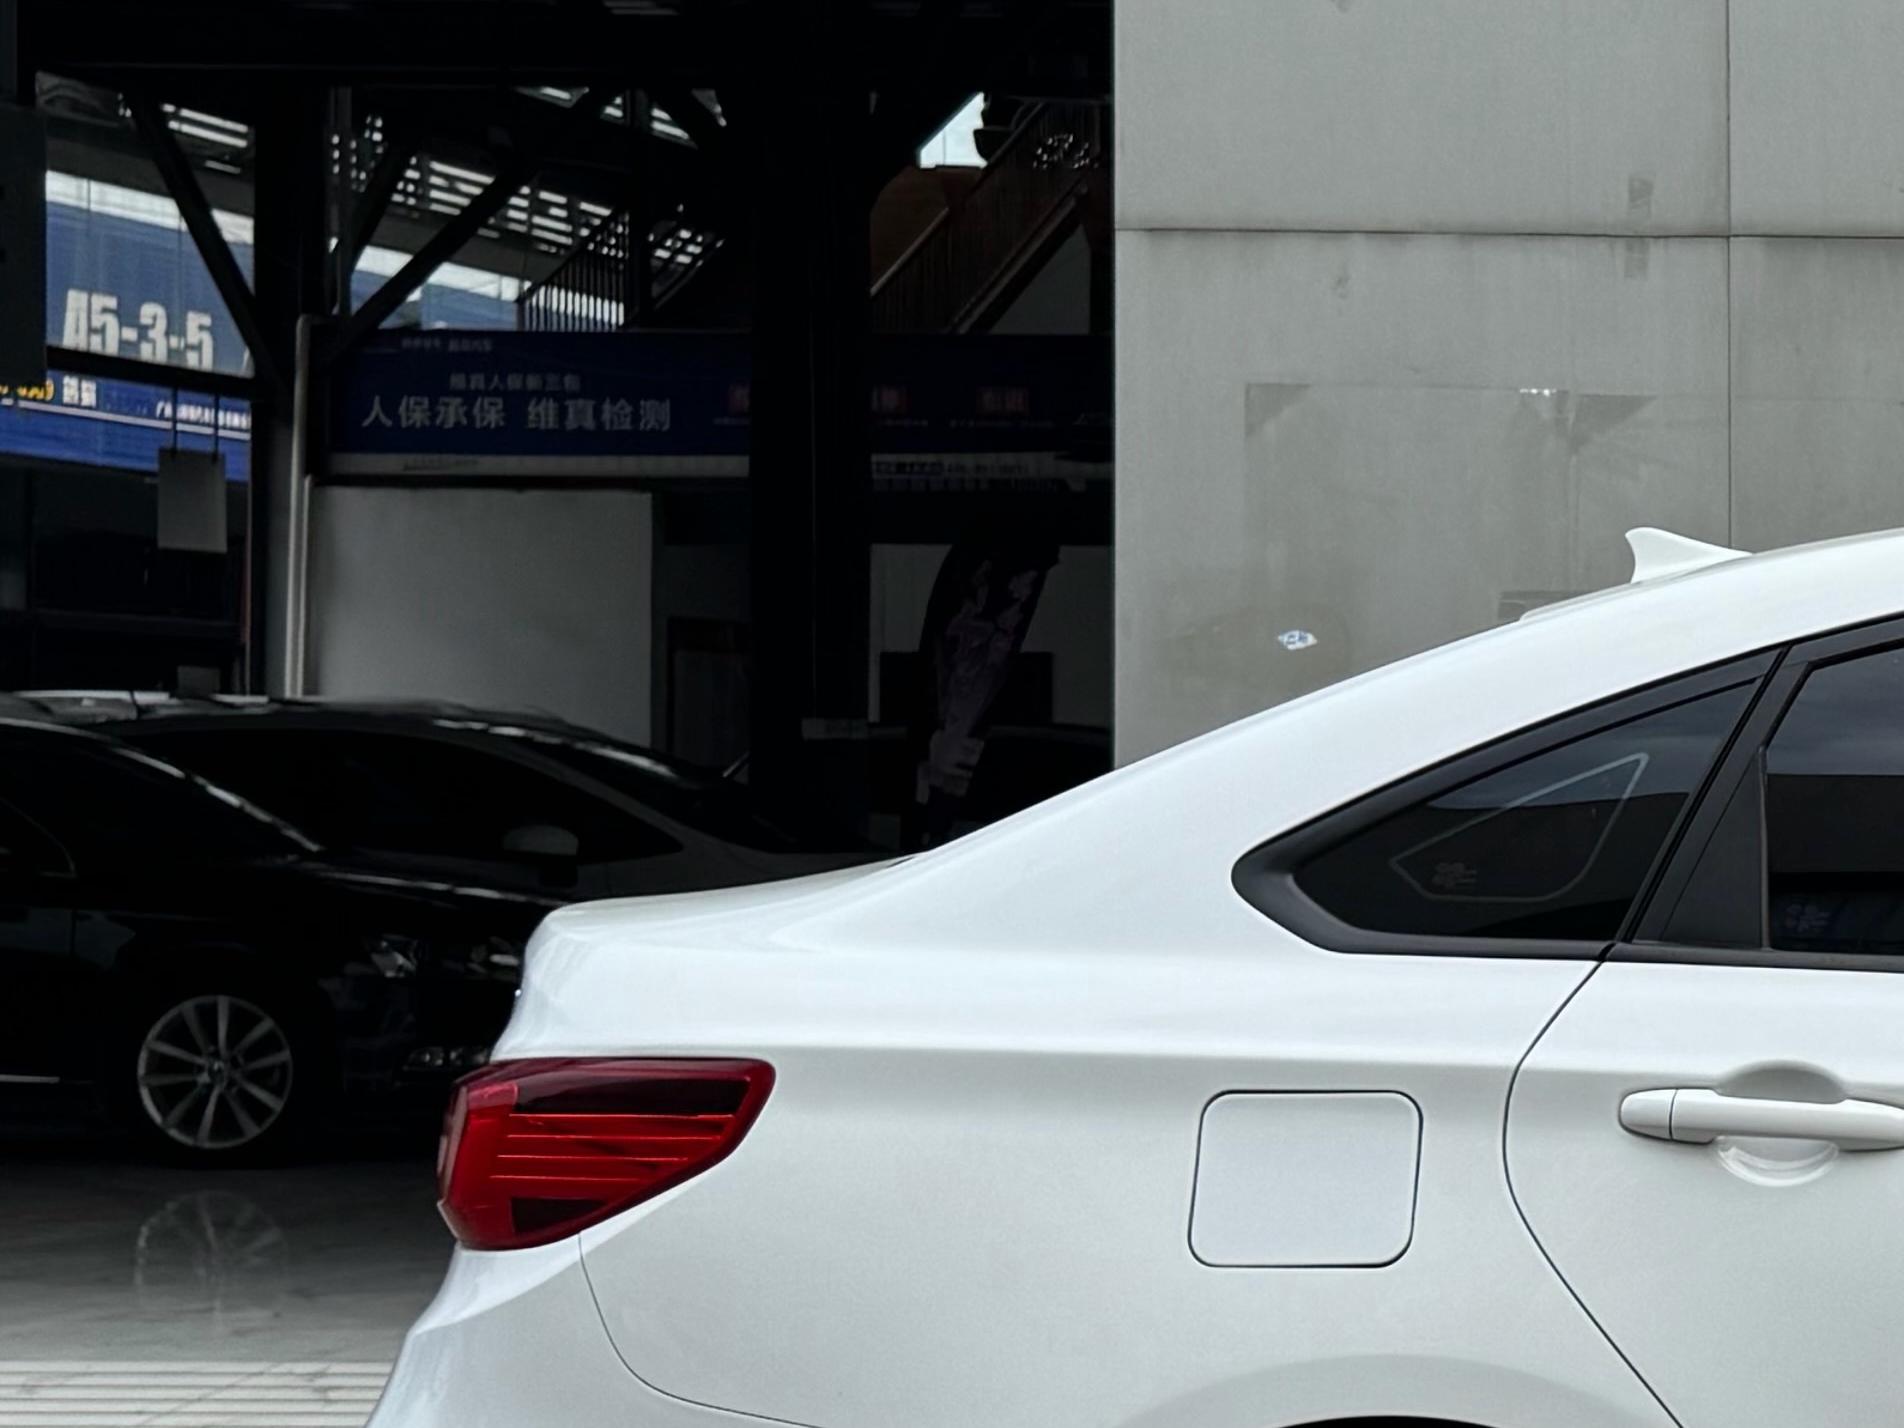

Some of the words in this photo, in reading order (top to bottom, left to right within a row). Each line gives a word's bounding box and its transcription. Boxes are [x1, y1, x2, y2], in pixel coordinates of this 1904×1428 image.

[362, 396, 504, 428] 人保承保
[527, 398, 670, 431] 维真检测
